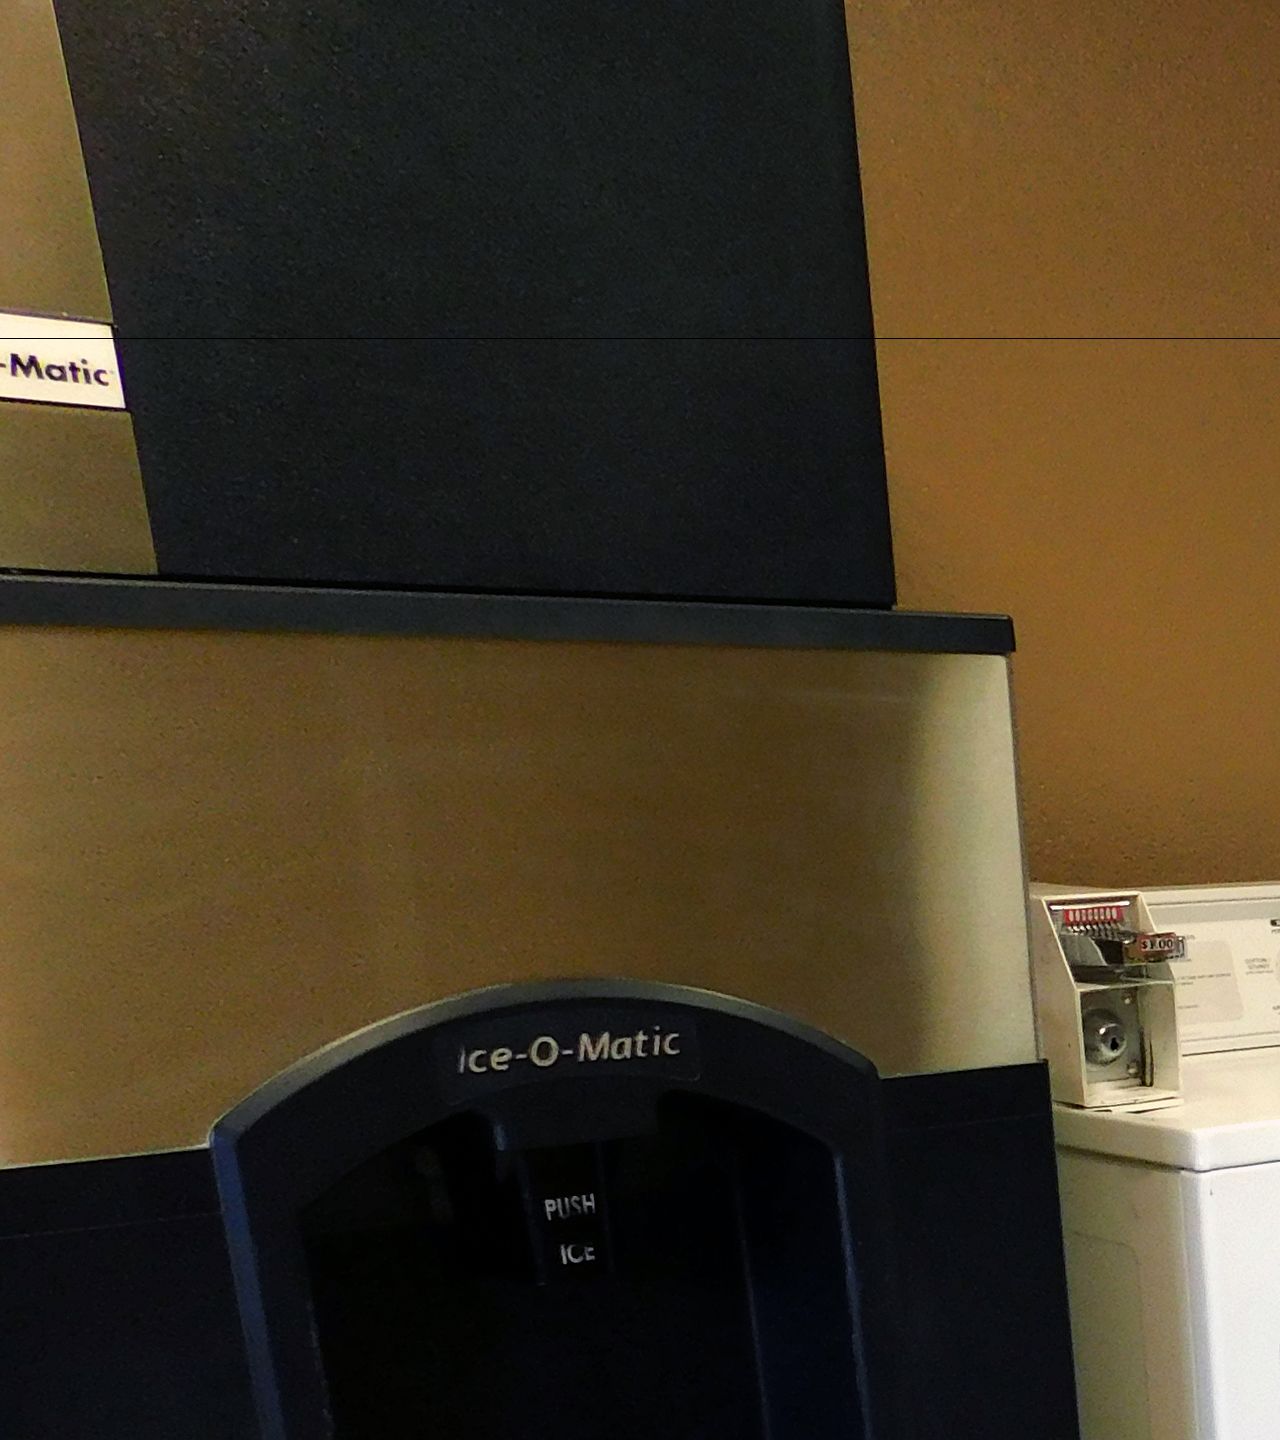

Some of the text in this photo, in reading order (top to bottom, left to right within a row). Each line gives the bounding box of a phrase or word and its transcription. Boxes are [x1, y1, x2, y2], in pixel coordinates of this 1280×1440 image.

[457, 1025, 681, 1074] Ice-O-Matic
[544, 1193, 596, 1221] PUSH
[560, 1244, 596, 1265] ICE
